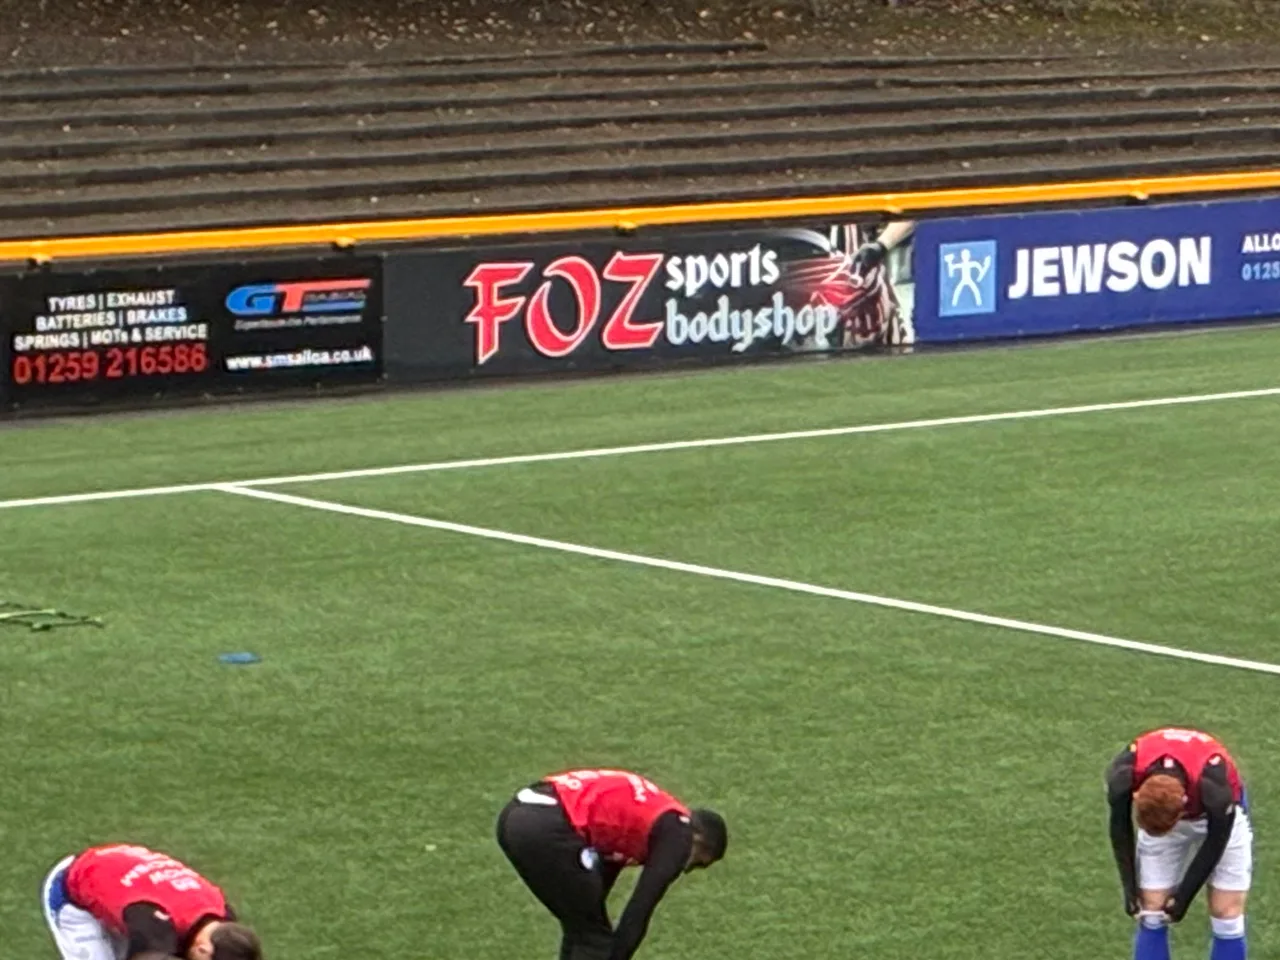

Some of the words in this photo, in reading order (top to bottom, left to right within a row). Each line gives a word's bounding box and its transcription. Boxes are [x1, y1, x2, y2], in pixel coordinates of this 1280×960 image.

[665, 243, 780, 298] sports
[1007, 236, 1213, 300] JEWSON
[35, 311, 116, 332] BATTERIES
[126, 306, 188, 326] BRAKES
[48, 294, 97, 312] TYRES
[106, 289, 176, 308] EXHAUST
[463, 250, 664, 364] FOZ
[665, 291, 840, 352] bodyshop
[14, 332, 80, 351] SPRINGS
[131, 326, 142, 343] &
[144, 323, 208, 342] SERVICE
[14, 350, 99, 385] 01259
[106, 342, 208, 378] 216586
